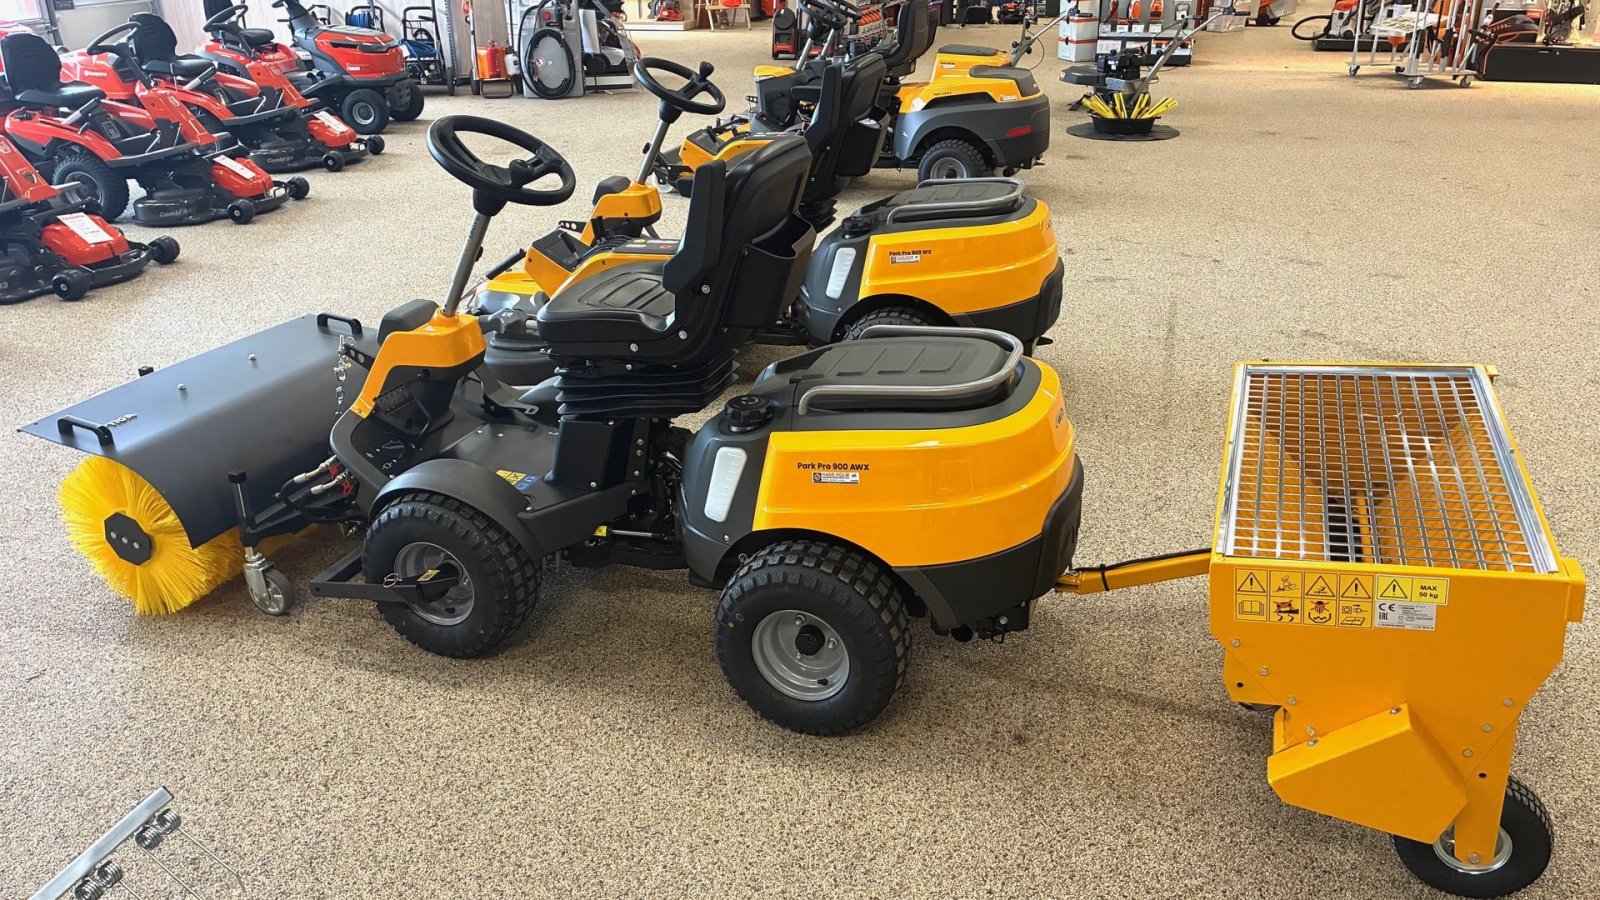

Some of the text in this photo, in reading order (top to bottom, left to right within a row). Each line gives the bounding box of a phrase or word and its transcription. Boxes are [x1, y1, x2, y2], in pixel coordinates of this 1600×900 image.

[797, 462, 816, 470] Park
[817, 462, 831, 470] Pro
[832, 463, 848, 471] 900
